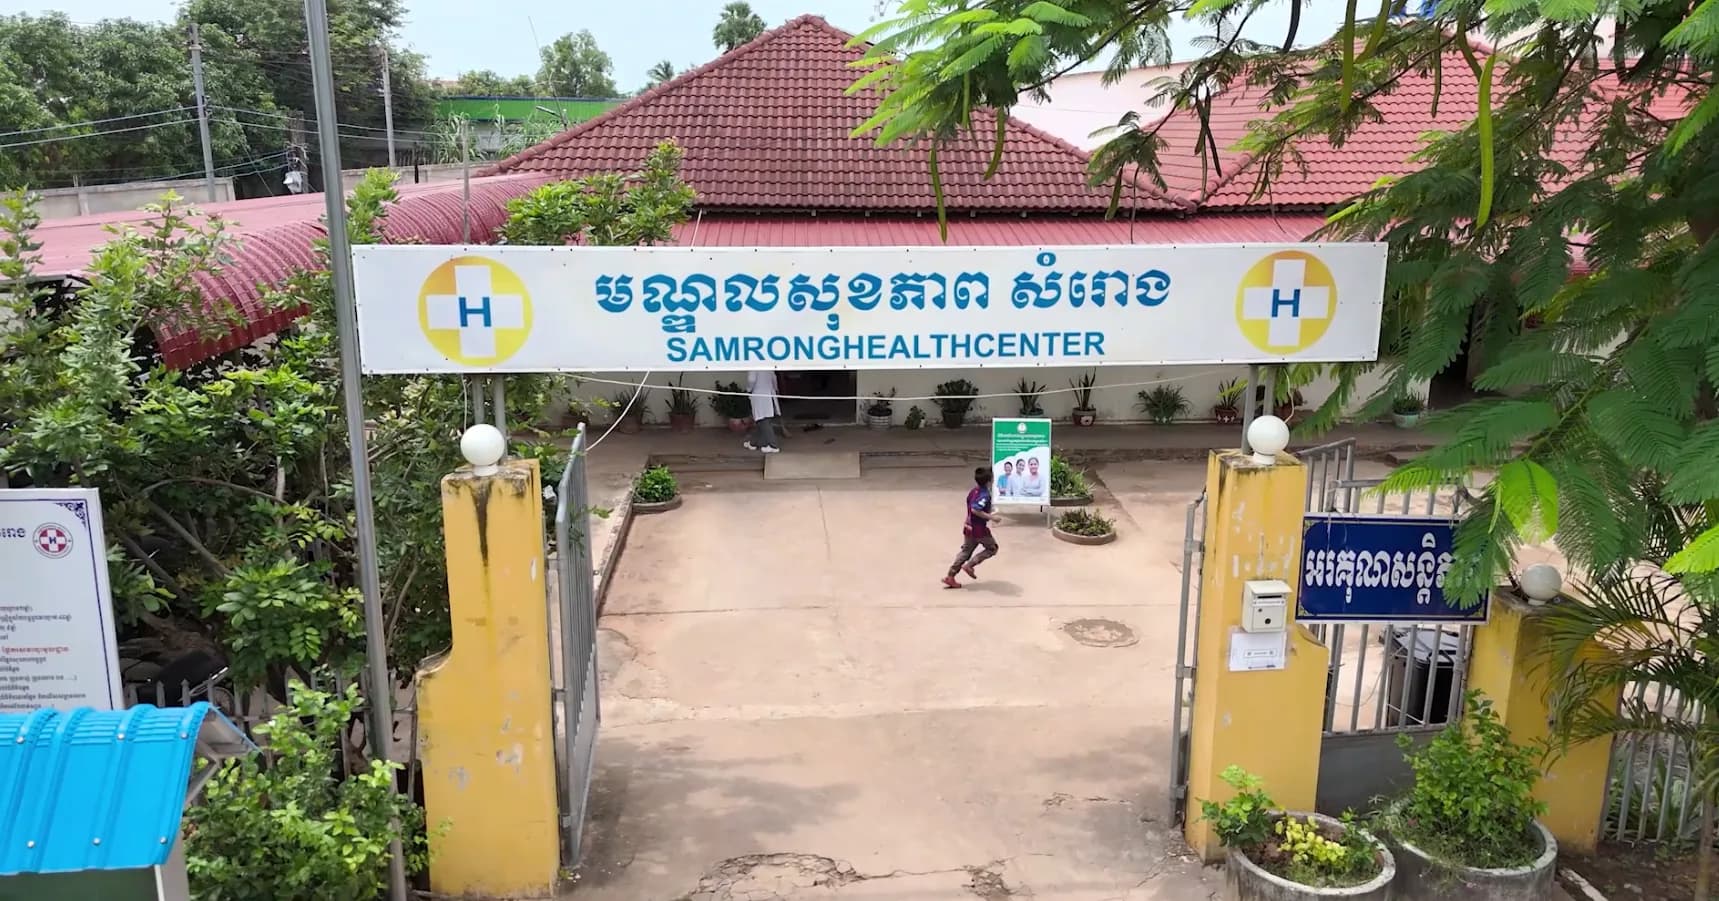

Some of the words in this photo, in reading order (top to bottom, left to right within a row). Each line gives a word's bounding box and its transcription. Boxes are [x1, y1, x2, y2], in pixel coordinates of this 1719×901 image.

[595, 272, 991, 334] មណ្ឌលសុខភាព
[1010, 251, 1171, 309] សំរោង
[1271, 288, 1301, 319] H
[458, 297, 492, 329] H
[666, 331, 1106, 362] SAMRONGHEALTHCENTER
